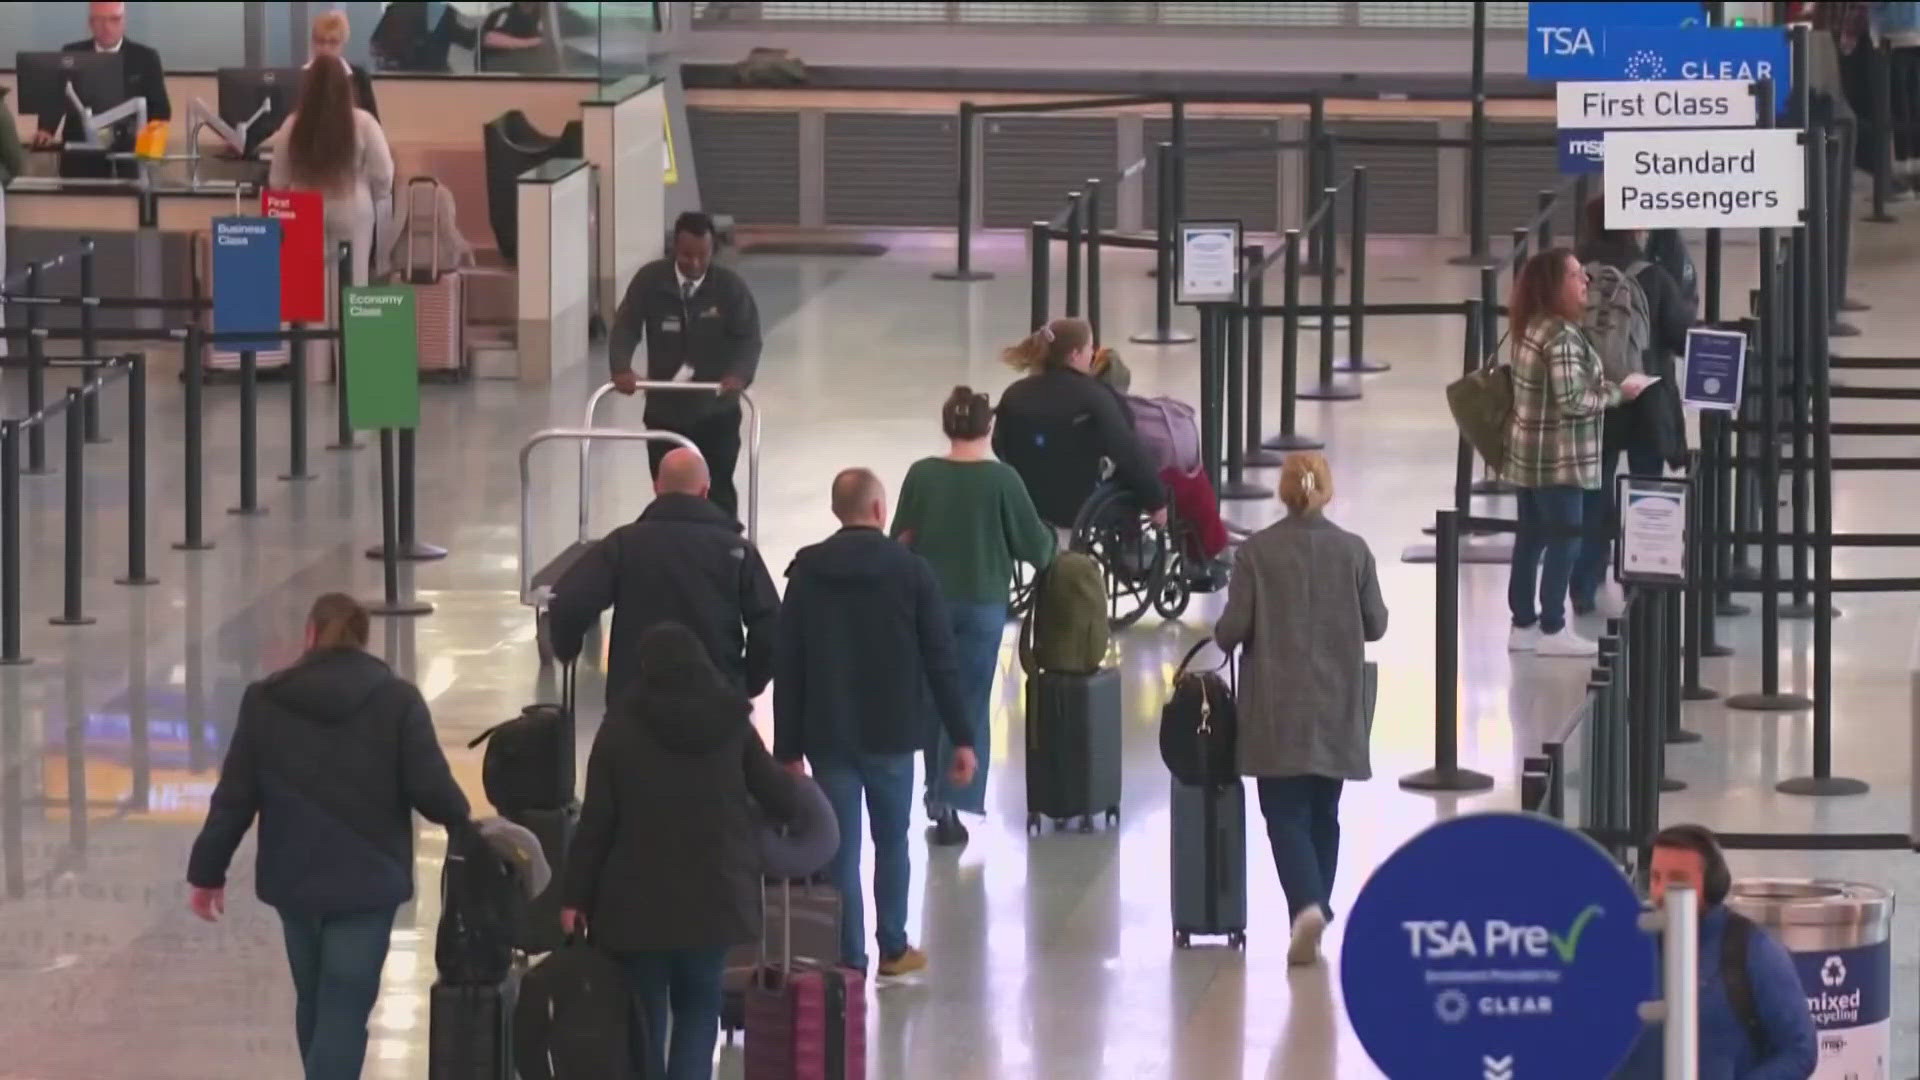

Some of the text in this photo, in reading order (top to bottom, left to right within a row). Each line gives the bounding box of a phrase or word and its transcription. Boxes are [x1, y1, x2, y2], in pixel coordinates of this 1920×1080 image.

[1536, 27, 1595, 55] TSA
[1681, 61, 1773, 80] CLEAR
[1583, 92, 1729, 117] First Class
[1634, 149, 1756, 175] Standard
[267, 196, 291, 208] First
[1621, 186, 1779, 215] Passengers
[267, 209, 297, 219] Class
[217, 224, 266, 235] Business
[217, 235, 249, 246] Class
[349, 294, 404, 306] Economy
[349, 306, 383, 317] Class
[1402, 920, 1549, 957] TSA Pre
[1479, 997, 1553, 1015] CLEAR
